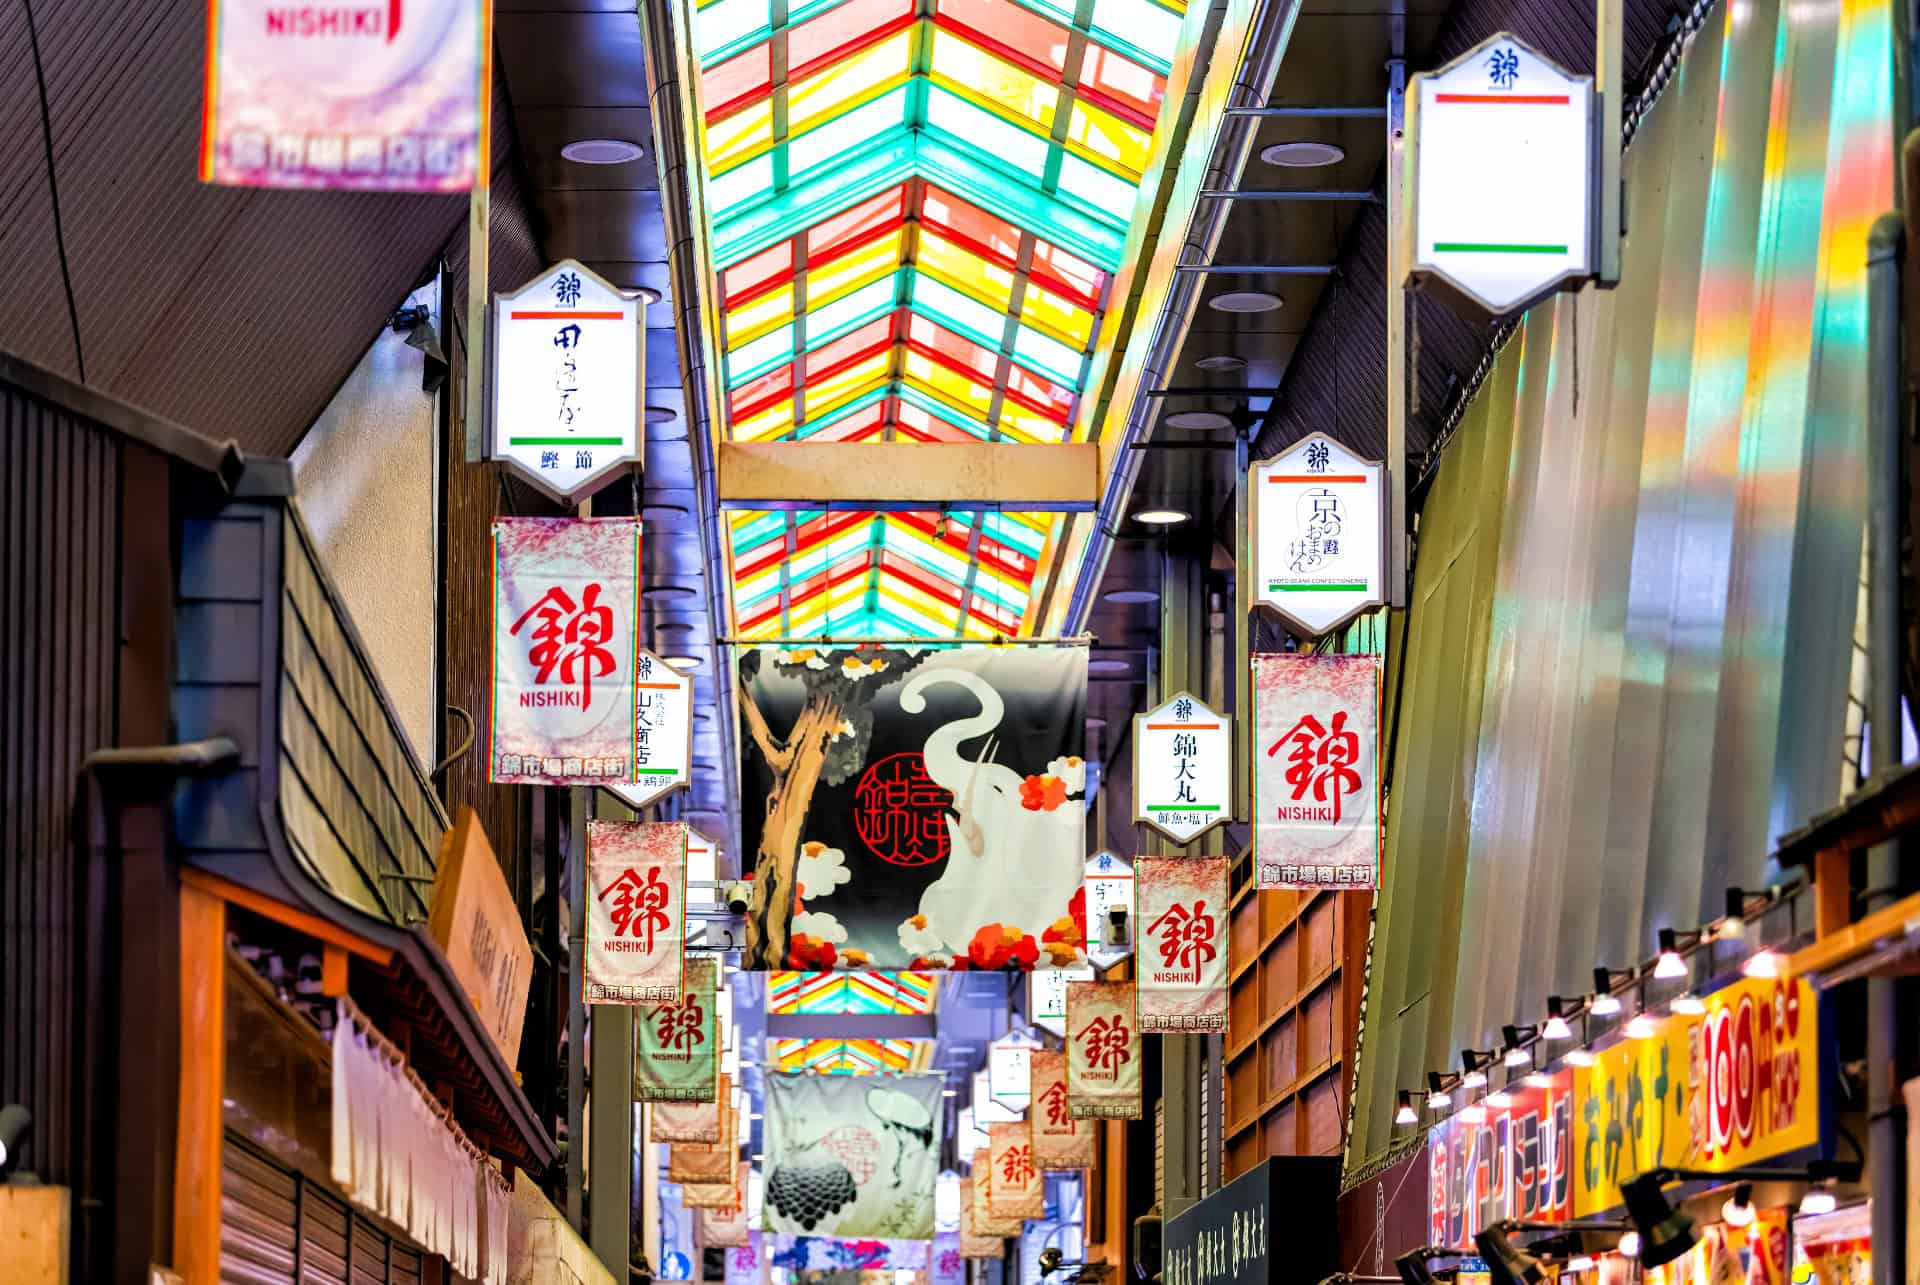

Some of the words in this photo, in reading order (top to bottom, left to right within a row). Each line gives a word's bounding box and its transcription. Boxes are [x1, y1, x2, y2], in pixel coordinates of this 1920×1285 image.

[265, 8, 382, 37] NISHIKI
[1483, 48, 1519, 90] 錦
[551, 272, 582, 308] 錦
[541, 450, 593, 469] 鰹節
[1303, 442, 1330, 473] 錦
[509, 583, 617, 713] 錦
[520, 690, 580, 708] NISHIKI
[1172, 698, 1193, 722] 錦
[500, 753, 625, 778] 錦市場商店街
[1173, 733, 1197, 803] 錦大丸
[1267, 711, 1363, 826] 錦
[1278, 806, 1332, 821] NISHIKI
[1262, 864, 1372, 884] 錦市場商店街
[598, 866, 670, 956] 錦
[604, 940, 647, 953] NISHIKI
[1146, 900, 1217, 986] 錦
[1154, 972, 1194, 983] NISHIKI
[646, 993, 705, 1065] 錦
[1142, 1014, 1224, 1031] 錦市場商店街
[1074, 1014, 1131, 1083] 錦
[1080, 1071, 1113, 1081] NISHIKI
